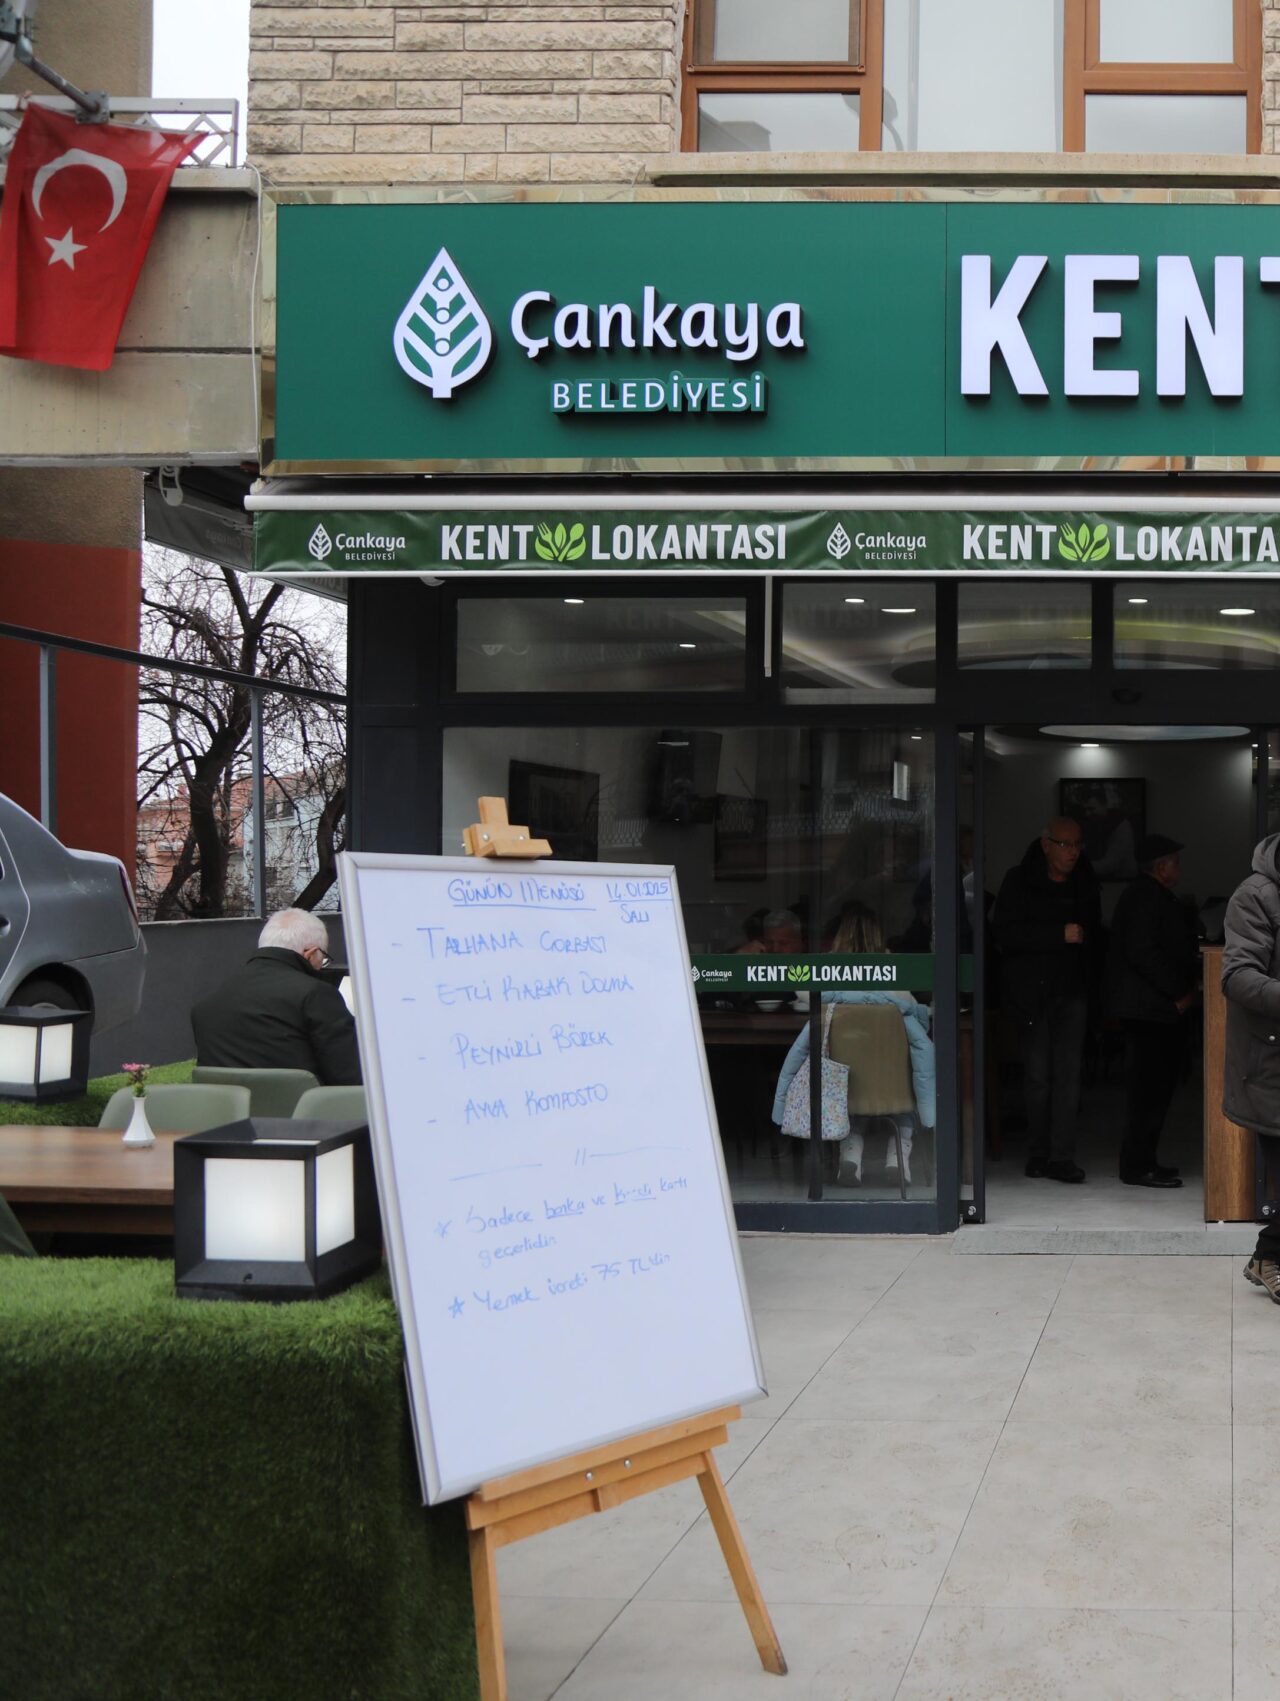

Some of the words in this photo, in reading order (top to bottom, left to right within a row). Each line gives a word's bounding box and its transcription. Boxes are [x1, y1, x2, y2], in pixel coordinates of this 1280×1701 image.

[511, 285, 805, 362] Çankaya
[552, 373, 765, 411] BELEDİYESİ
[335, 532, 406, 551] Çankaya
[441, 524, 534, 561] KENT
[591, 523, 787, 561] LOKANTASI
[855, 531, 927, 551] Çankaya
[963, 524, 1057, 560] KENT
[344, 550, 396, 561] BELEDİYESİ
[865, 550, 917, 560] BELEDİYESİ
[447, 877, 513, 903] GÜNÜN
[747, 965, 788, 982] KENT
[812, 965, 897, 982] LOKANTASI
[502, 974, 570, 1002] KABAK
[549, 1023, 614, 1054] BÖREK
[463, 1097, 509, 1124] AYVA
[465, 1204, 534, 1233] Sadece
[590, 1261, 622, 1281] 75
